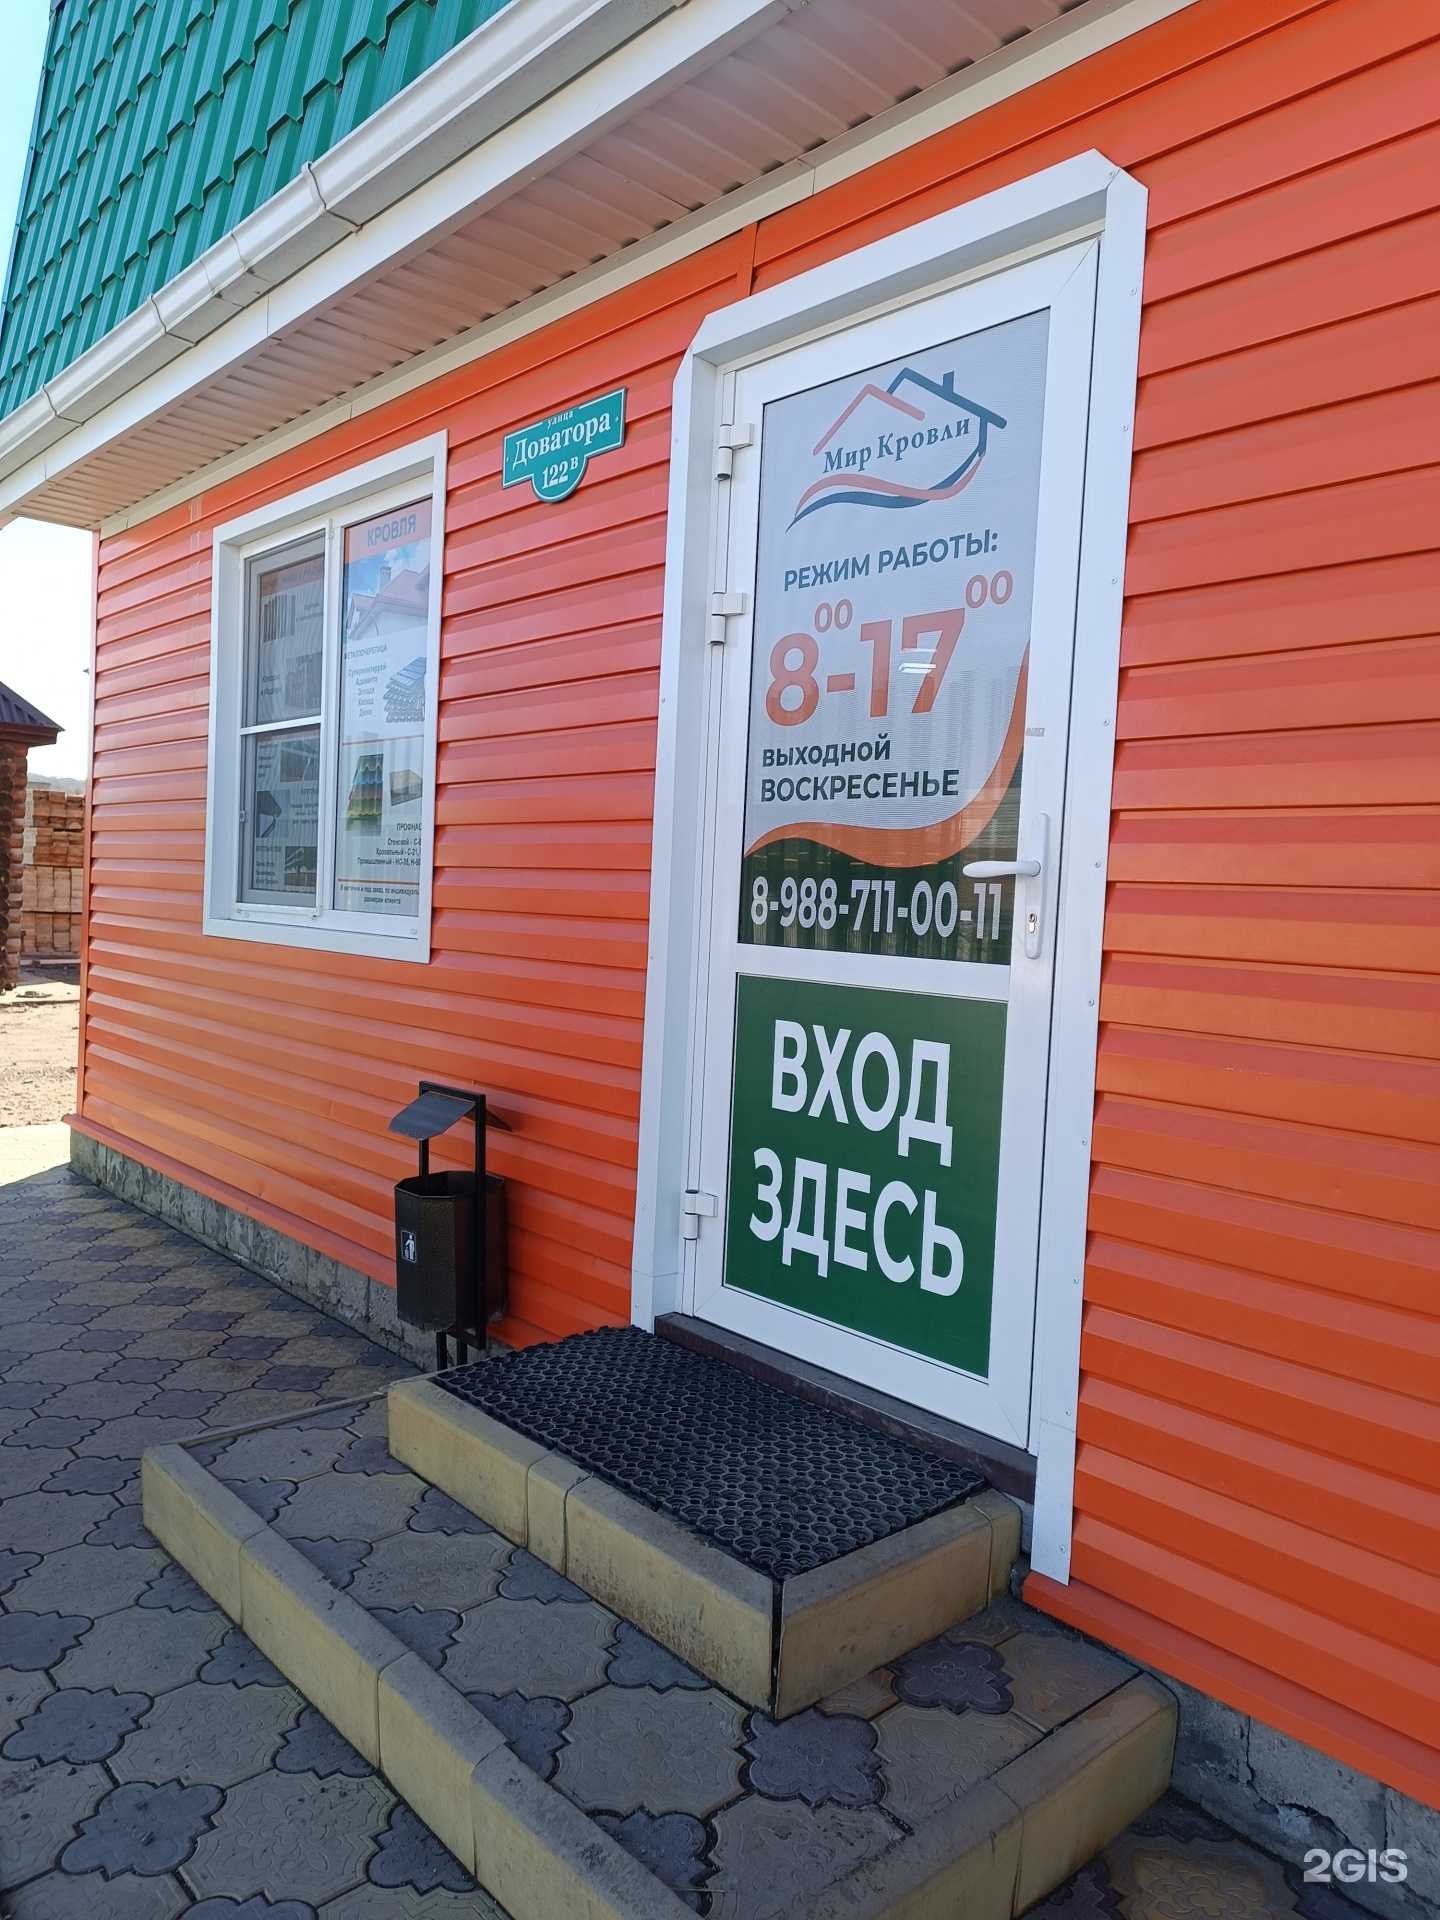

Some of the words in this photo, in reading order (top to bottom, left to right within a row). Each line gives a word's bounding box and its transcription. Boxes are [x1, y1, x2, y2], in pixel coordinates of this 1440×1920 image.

[512, 412, 611, 471] Доватора
[547, 410, 575, 430] улица
[822, 447, 872, 474] Мир
[876, 418, 970, 461] Кровли
[367, 514, 417, 548] КРОВЛЯ
[784, 553, 870, 592] РЕЖИМ
[878, 529, 999, 574] РАБОТЫ:
[761, 769, 960, 803] ВОСКРЕСЕНЬЕ
[751, 876, 1002, 941] 8-988-711-00-11
[771, 1018, 953, 1168] ВХОД
[749, 1146, 965, 1298] ЗДЕСЬ
